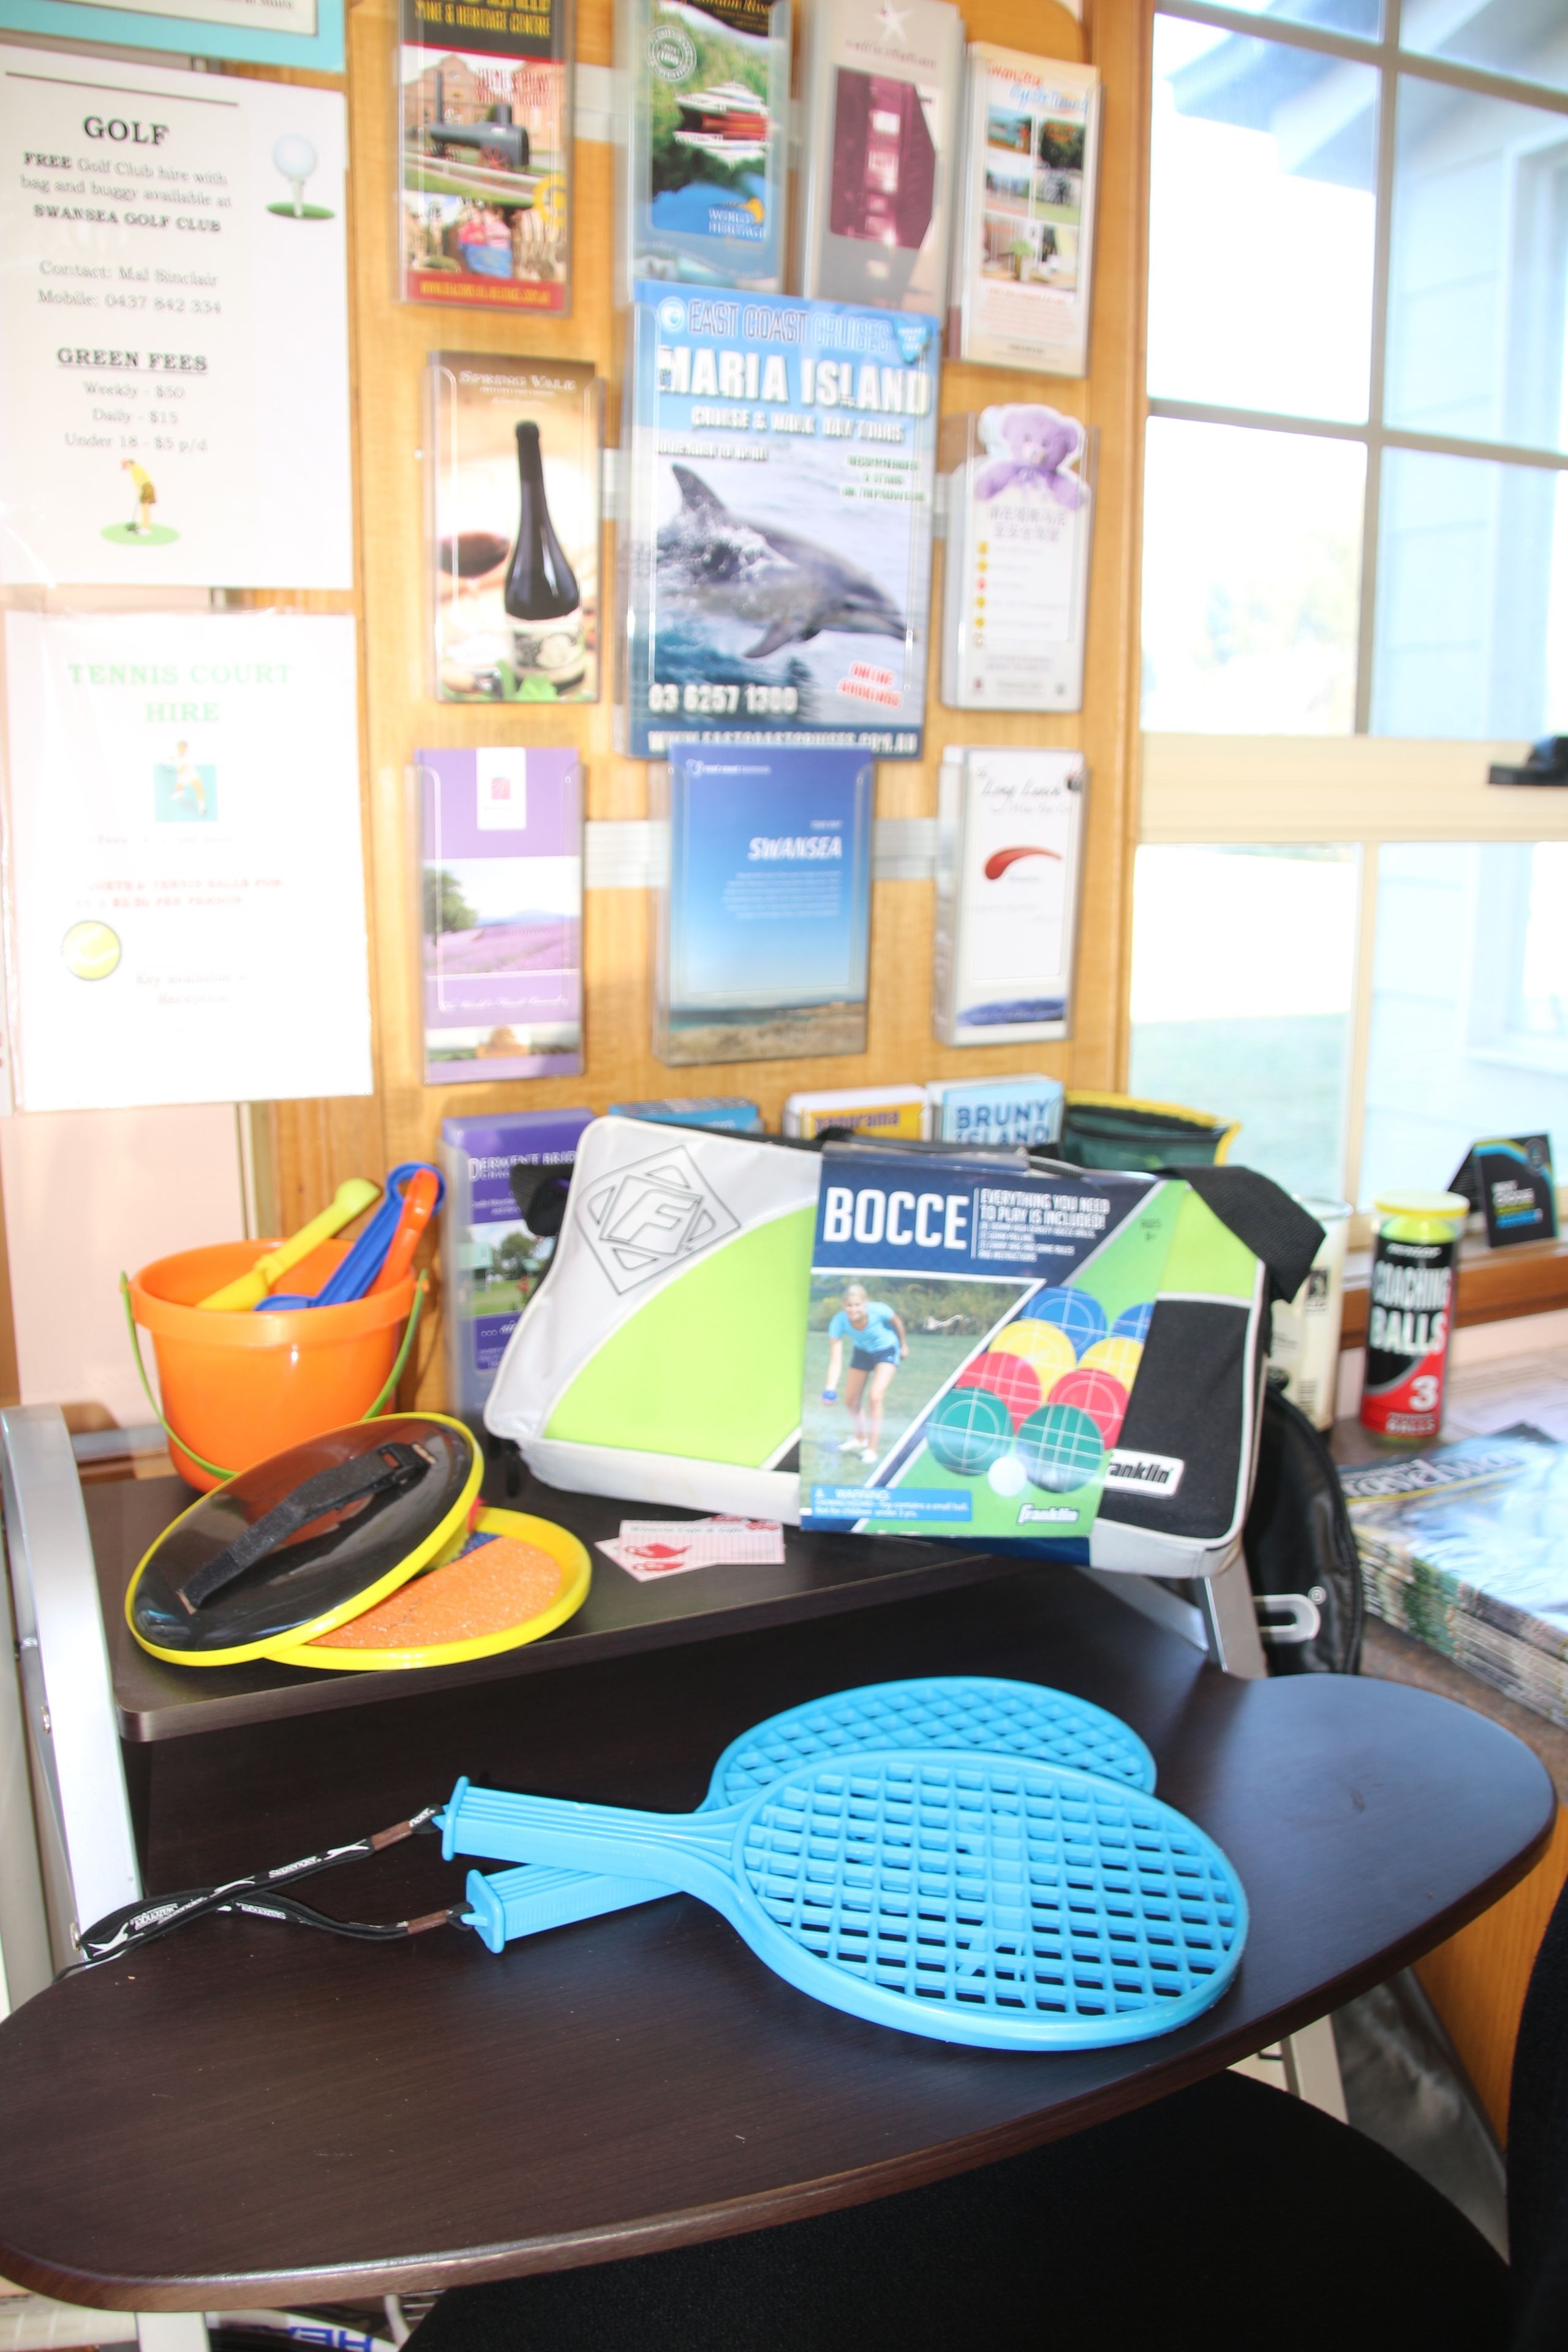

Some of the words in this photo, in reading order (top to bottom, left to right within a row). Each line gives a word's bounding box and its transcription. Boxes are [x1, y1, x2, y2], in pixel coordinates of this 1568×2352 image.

[83, 116, 170, 145] GOLF
[23, 151, 72, 169] FREE
[77, 157, 111, 174] Golf
[115, 161, 154, 178] Club
[159, 167, 191, 182] hire
[194, 172, 228, 186] with
[21, 174, 49, 193] bag
[54, 179, 86, 194] and
[91, 182, 139, 203] buggy
[143, 186, 212, 207] available
[216, 195, 232, 208] at
[34, 204, 119, 225] SWANSEA
[125, 214, 171, 229] GOLF
[176, 217, 221, 233] CLUB
[39, 261, 111, 280] Contact:
[119, 266, 149, 282] Mal
[155, 270, 219, 287] Sinclair
[38, 288, 99, 306] Mobile:
[105, 294, 147, 309] 0437
[688, 299, 738, 335] EAST
[743, 305, 807, 342] COAST
[812, 313, 891, 351] CRUISES
[57, 347, 140, 368] GREEN
[148, 352, 208, 372] FEES
[83, 380, 138, 399] Weekly
[155, 385, 185, 400] $50
[657, 345, 788, 402] MARIA
[801, 359, 930, 415] ISLAND
[92, 407, 133, 424] Daily
[149, 410, 179, 424] $15
[692, 405, 750, 428] CRUISE
[753, 412, 767, 430] &
[823, 417, 853, 438] DAY
[64, 432, 113, 448] Under
[120, 435, 138, 449] 18
[178, 438, 208, 456] p/d
[69, 663, 178, 685] TENNIS
[190, 663, 293, 684] COURT
[146, 702, 219, 723] HIRE
[648, 684, 678, 712] 03
[684, 684, 740, 714] 6257
[745, 685, 797, 714] 1300
[748, 836, 842, 860] SWANSEA
[958, 1099, 1048, 1129] BRUNY
[981, 1188, 1052, 1210] EVERYTHING
[1053, 1195, 1078, 1212] YOU
[1079, 1197, 1110, 1215] NEED
[823, 1186, 970, 1250] BOCCE
[980, 1205, 997, 1220] TO
[997, 1207, 1028, 1223] PLAY
[1029, 1209, 1042, 1224] IS
[1044, 1210, 1106, 1229] INCLUDED!
[1373, 1259, 1451, 1311] COACHING
[1370, 1305, 1447, 1355] BALLS
[1409, 1374, 1439, 1412] 3
[1109, 1461, 1169, 1483] anklin
[835, 1488, 891, 1500] WARNING:
[133, 1903, 178, 1930] Slazenger
[238, 1902, 286, 1920] Slazenger
